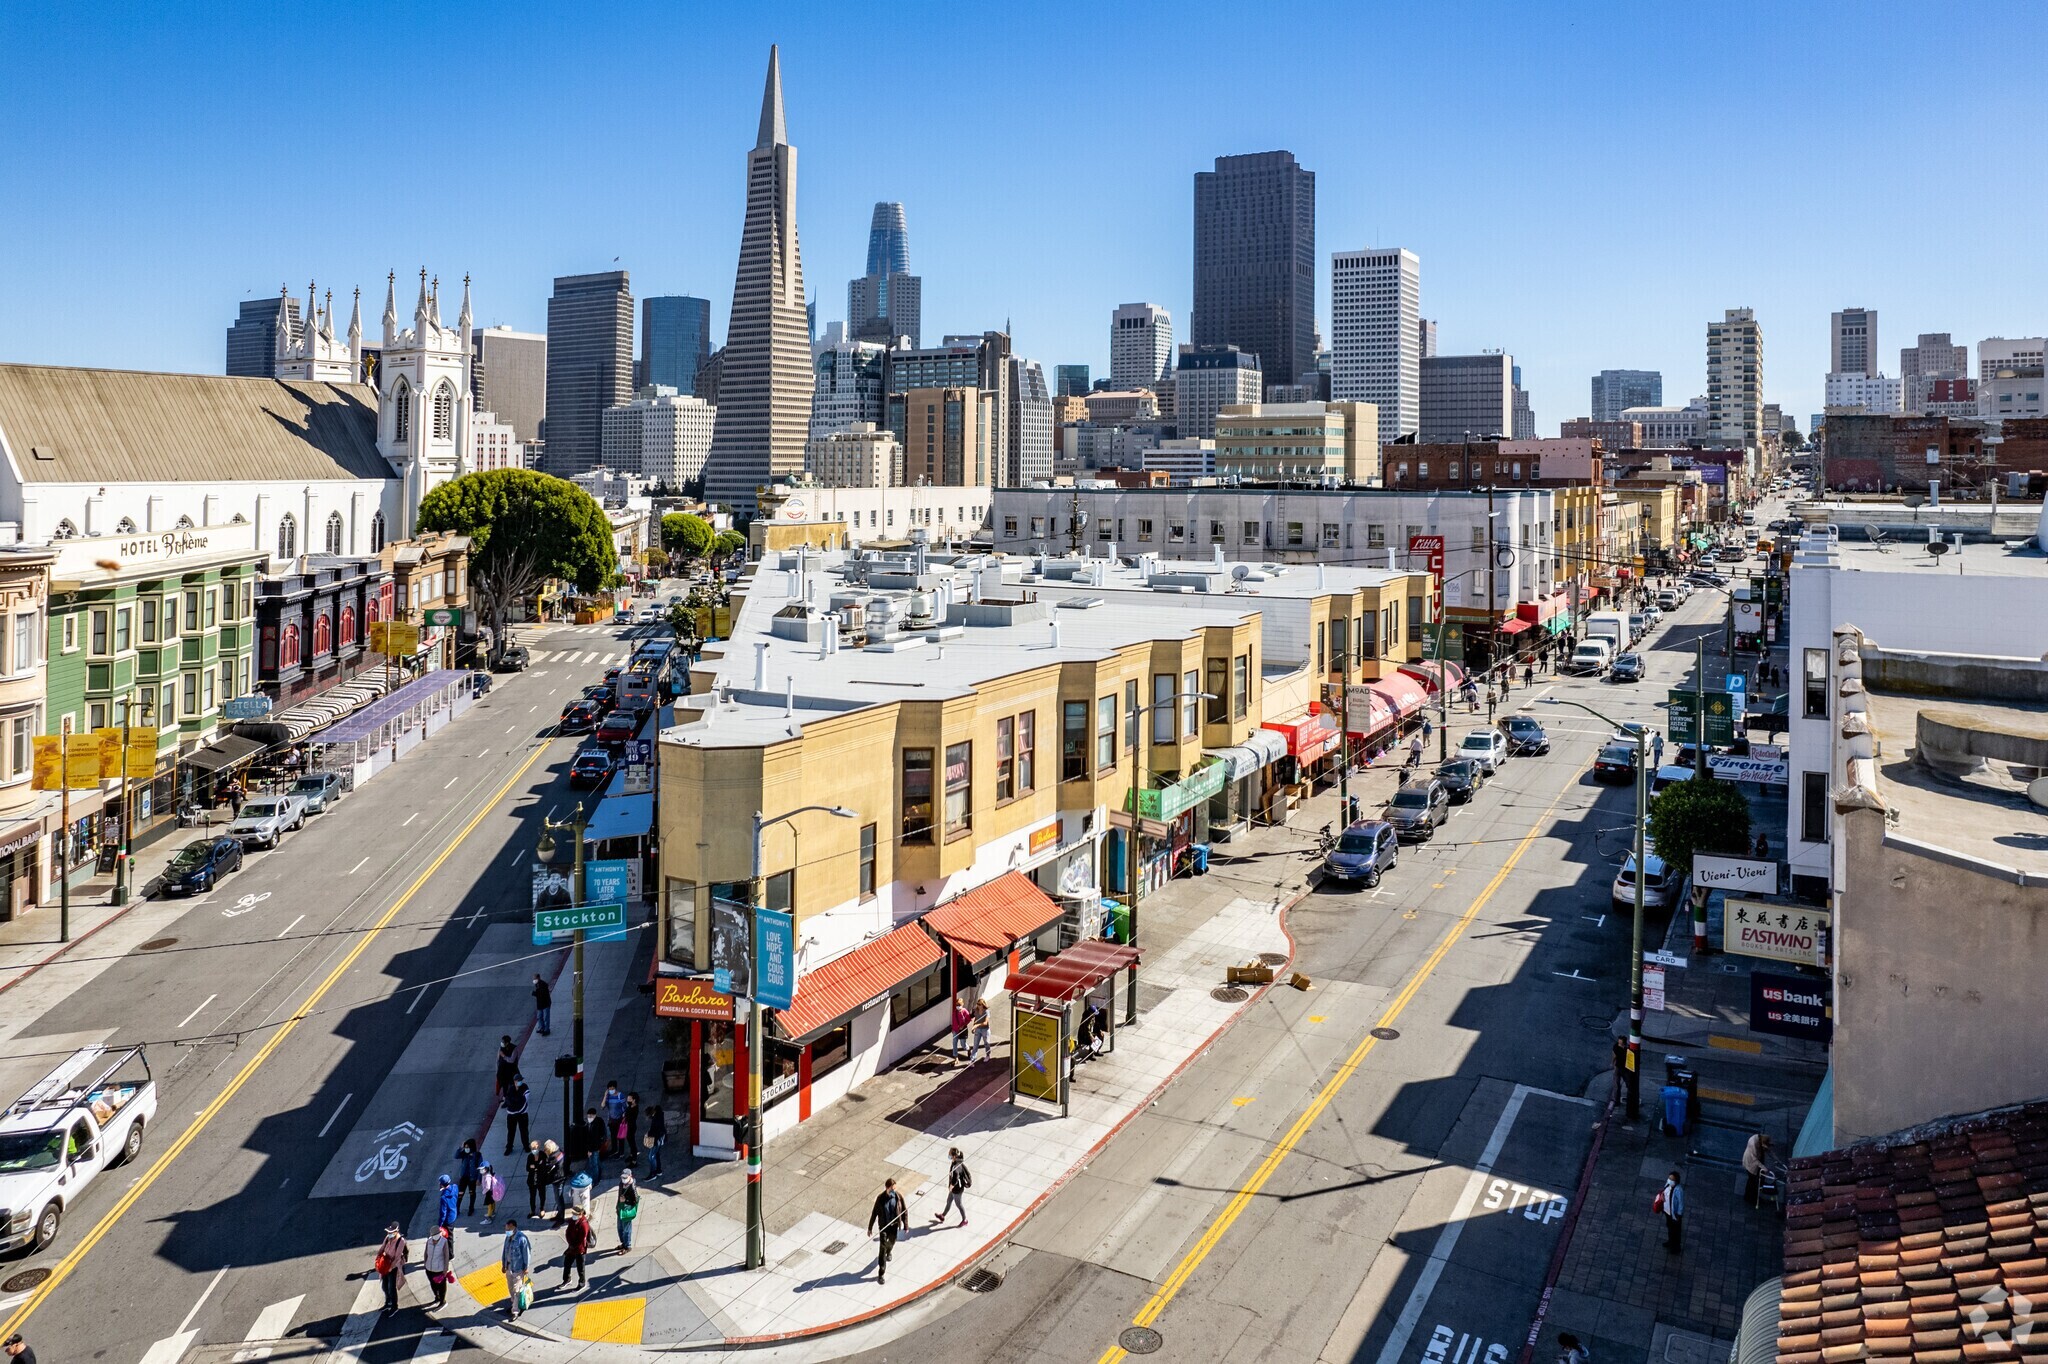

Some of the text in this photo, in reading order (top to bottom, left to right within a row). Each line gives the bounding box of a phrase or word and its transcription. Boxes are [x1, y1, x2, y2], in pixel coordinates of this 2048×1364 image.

[120, 532, 208, 558] HOTEL Bohème
[1412, 538, 1442, 550] Little
[1431, 555, 1443, 620] CITY
[231, 701, 268, 709] STELLA
[1709, 757, 1785, 773] Firenze
[1740, 770, 1774, 781] By Night
[1700, 866, 1767, 882] Vieni-Vieni
[602, 878, 620, 886] YEARS
[543, 911, 616, 928] Stockton
[763, 916, 790, 929] ANTHONY'S
[1735, 907, 1808, 931] 東風書店
[766, 931, 784, 947] LOVE,
[1741, 928, 1812, 950] EASTWIND
[1741, 941, 1762, 950] BOOKS
[766, 942, 784, 956] HOPE,
[769, 953, 782, 964] AND
[1655, 955, 1676, 964] CARD
[767, 963, 784, 975] COUS
[767, 973, 784, 986] COUS
[660, 984, 728, 1006] Barbara
[862, 990, 890, 1011] restaurant
[659, 1005, 684, 1013] PINSERIA
[762, 1076, 796, 1101] STOCKTON
[1482, 1179, 1569, 1225] STOP
[1542, 1286, 1553, 1300] BUS
[1536, 1300, 1549, 1316] STOP
